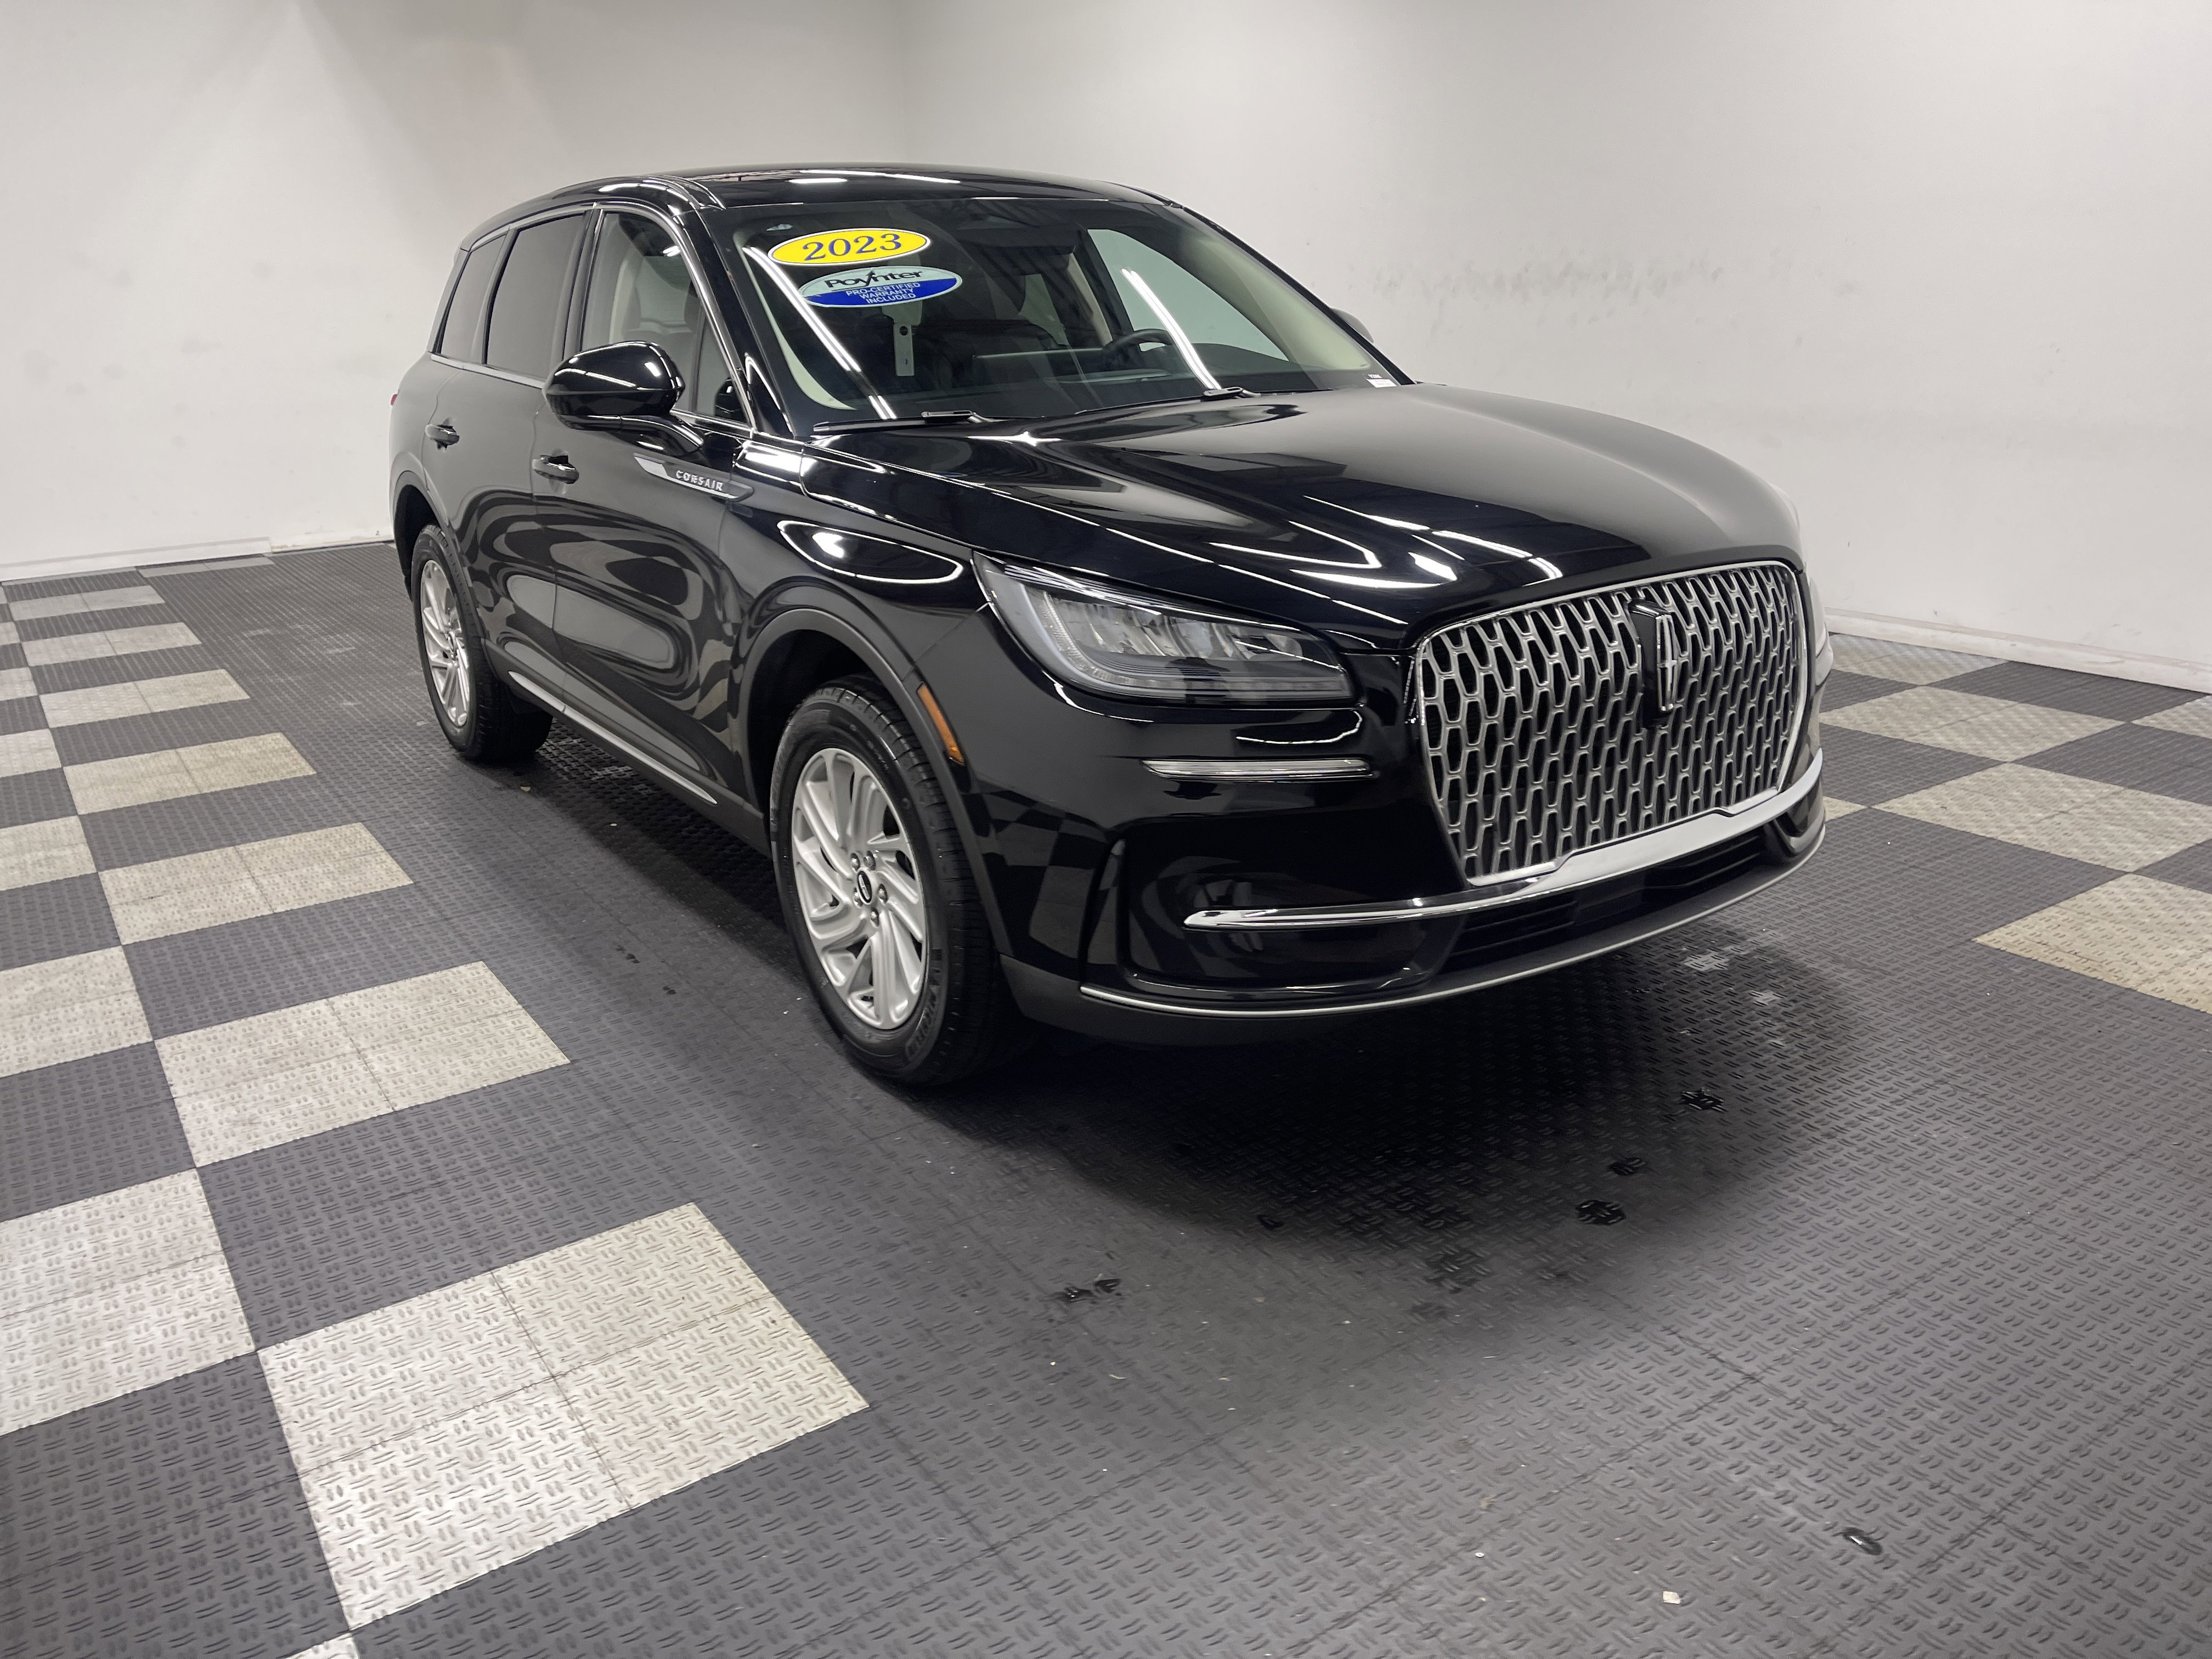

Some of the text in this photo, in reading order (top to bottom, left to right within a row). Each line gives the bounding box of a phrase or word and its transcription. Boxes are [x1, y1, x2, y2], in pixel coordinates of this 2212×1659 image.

[802, 233, 902, 262] 2023
[824, 268, 923, 291] Poynter
[845, 282, 921, 296] PRO-CERTIFIED
[859, 288, 915, 300] WARRANTY
[866, 293, 917, 304] INCLUDED
[675, 470, 724, 491] CORSAIR
